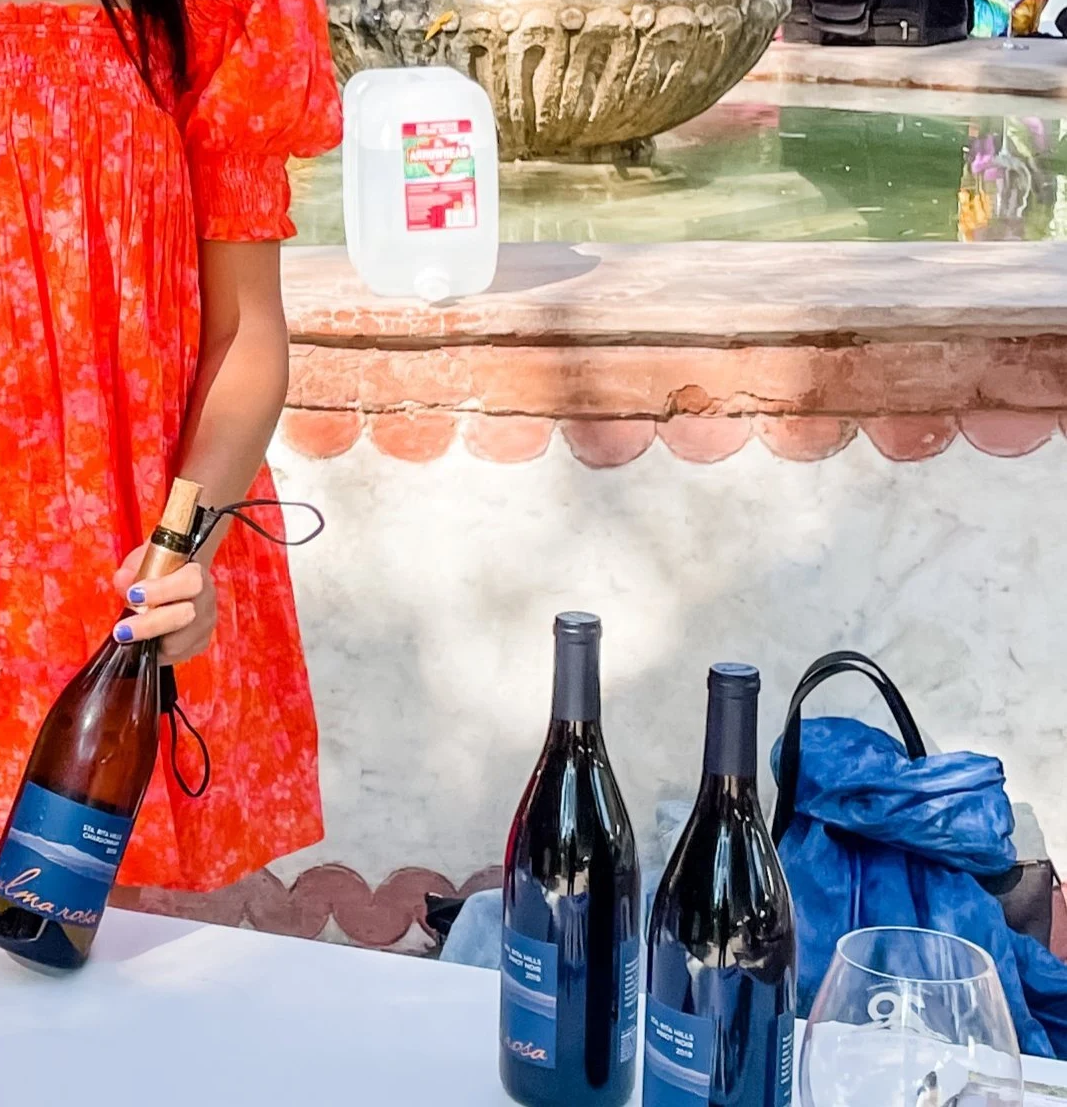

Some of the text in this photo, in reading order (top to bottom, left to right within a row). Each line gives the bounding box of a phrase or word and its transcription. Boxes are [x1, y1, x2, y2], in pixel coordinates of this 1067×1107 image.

[410, 145, 469, 162] ARROWHEAD
[57, 907, 98, 923] rosa
[523, 954, 542, 966] HILLS
[524, 962, 541, 973] NOIR
[673, 1029, 694, 1042] HILLS
[674, 1037, 693, 1049] NOIR
